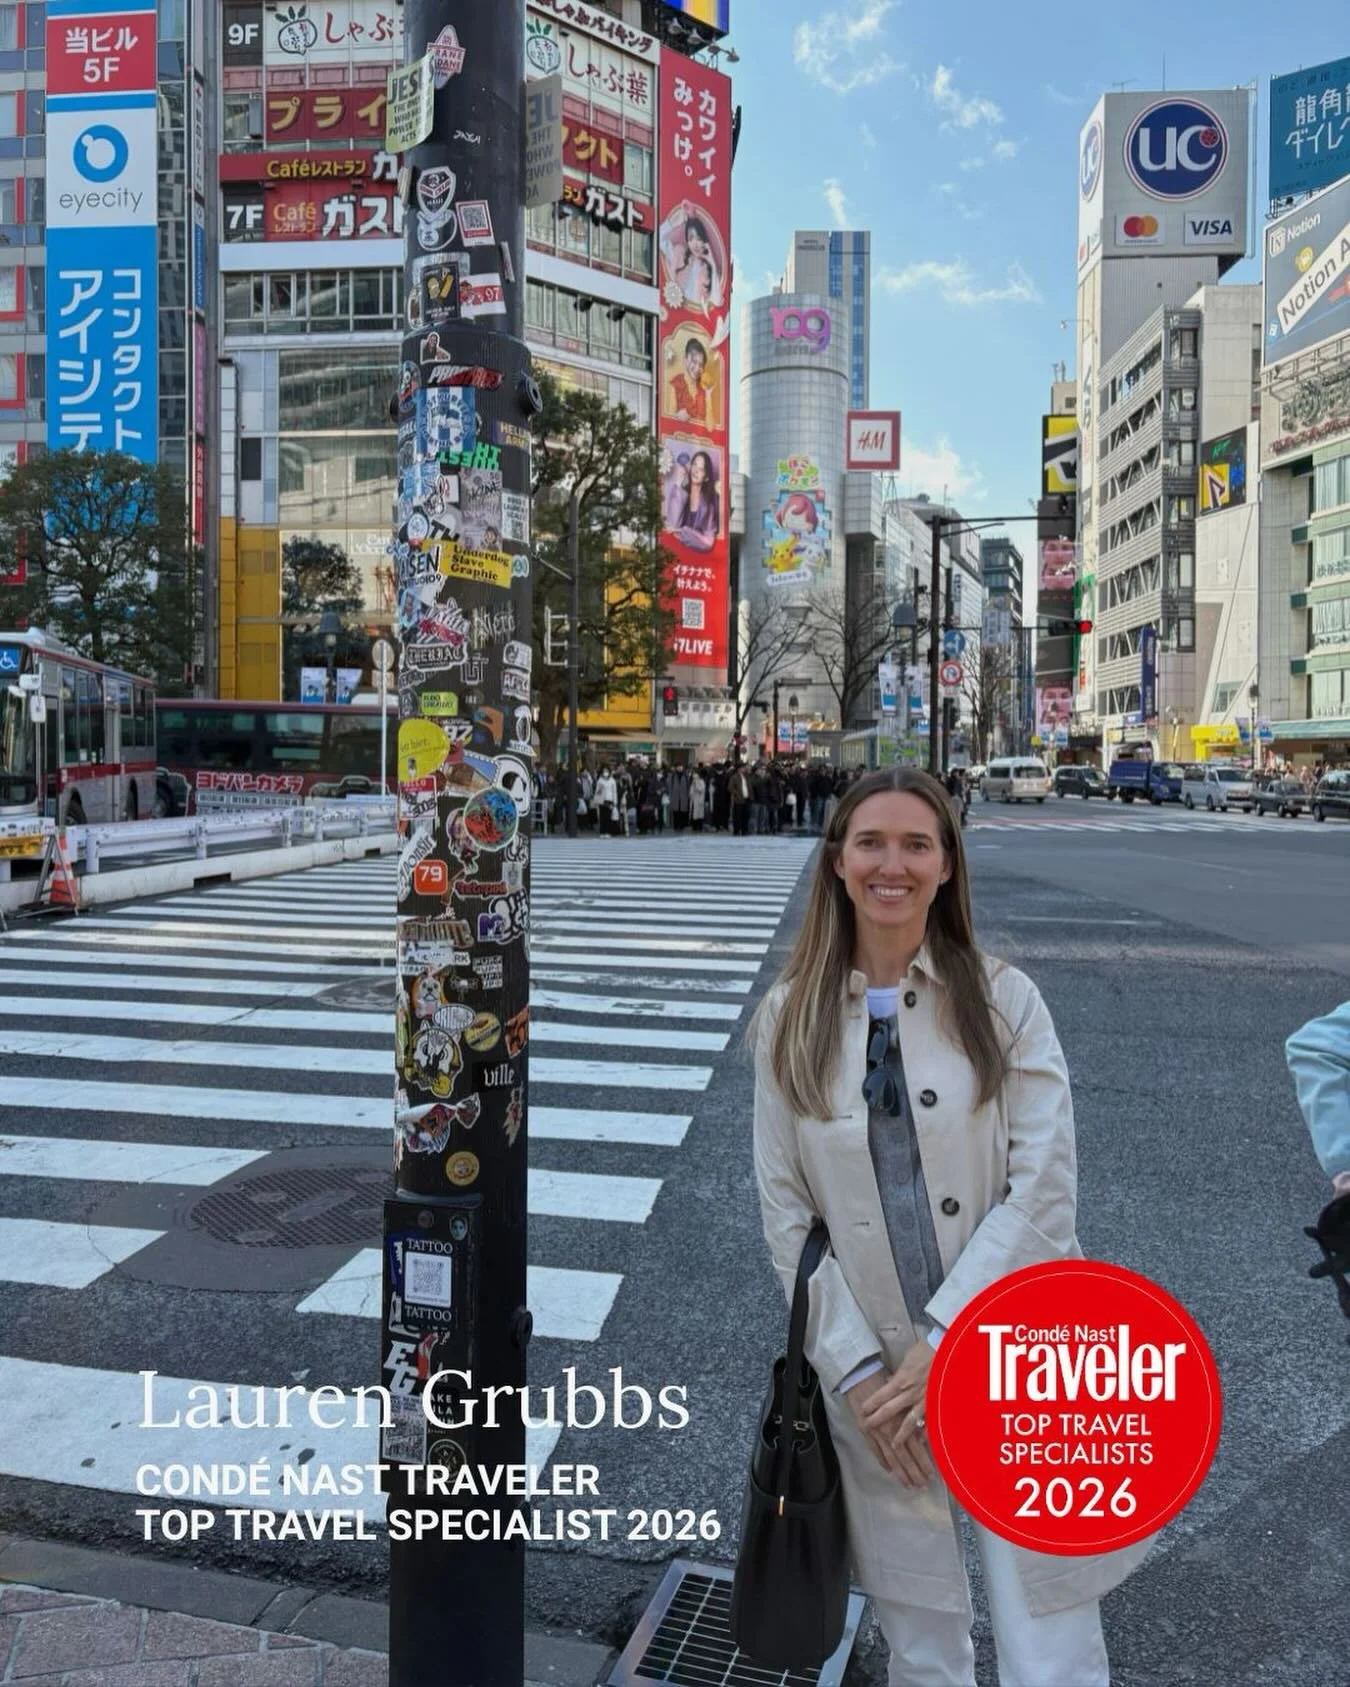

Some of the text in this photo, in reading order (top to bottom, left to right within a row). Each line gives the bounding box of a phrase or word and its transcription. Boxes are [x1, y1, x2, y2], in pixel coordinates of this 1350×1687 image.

[65, 26, 138, 54] 当ビル
[228, 23, 259, 45] 9F
[325, 12, 404, 43] しゃぶ
[83, 56, 120, 83] 5F
[569, 43, 648, 104] しゃぶ葉
[1295, 83, 1350, 127] 龍角
[674, 77, 693, 176] みつけ。
[698, 89, 716, 197] カワイイ
[59, 187, 143, 216] eyecity
[273, 202, 317, 221] Café
[585, 187, 644, 228] ガスト
[226, 205, 264, 229] 7F
[1190, 220, 1233, 236] VISA
[1287, 213, 1321, 241] Notion
[485, 287, 501, 300] 97
[1282, 258, 1337, 324] Notion
[769, 305, 831, 352] 109
[113, 269, 142, 463] コンタクト
[452, 553, 484, 568] Slave
[454, 544, 510, 568] Underdog
[451, 564, 499, 580] Graphic
[196, 771, 304, 793] ヨドバシカメラ
[419, 866, 442, 883] 79
[484, 1063, 515, 1087] ville
[406, 1238, 453, 1253] TATTOO
[404, 1306, 452, 1321] TATTOO
